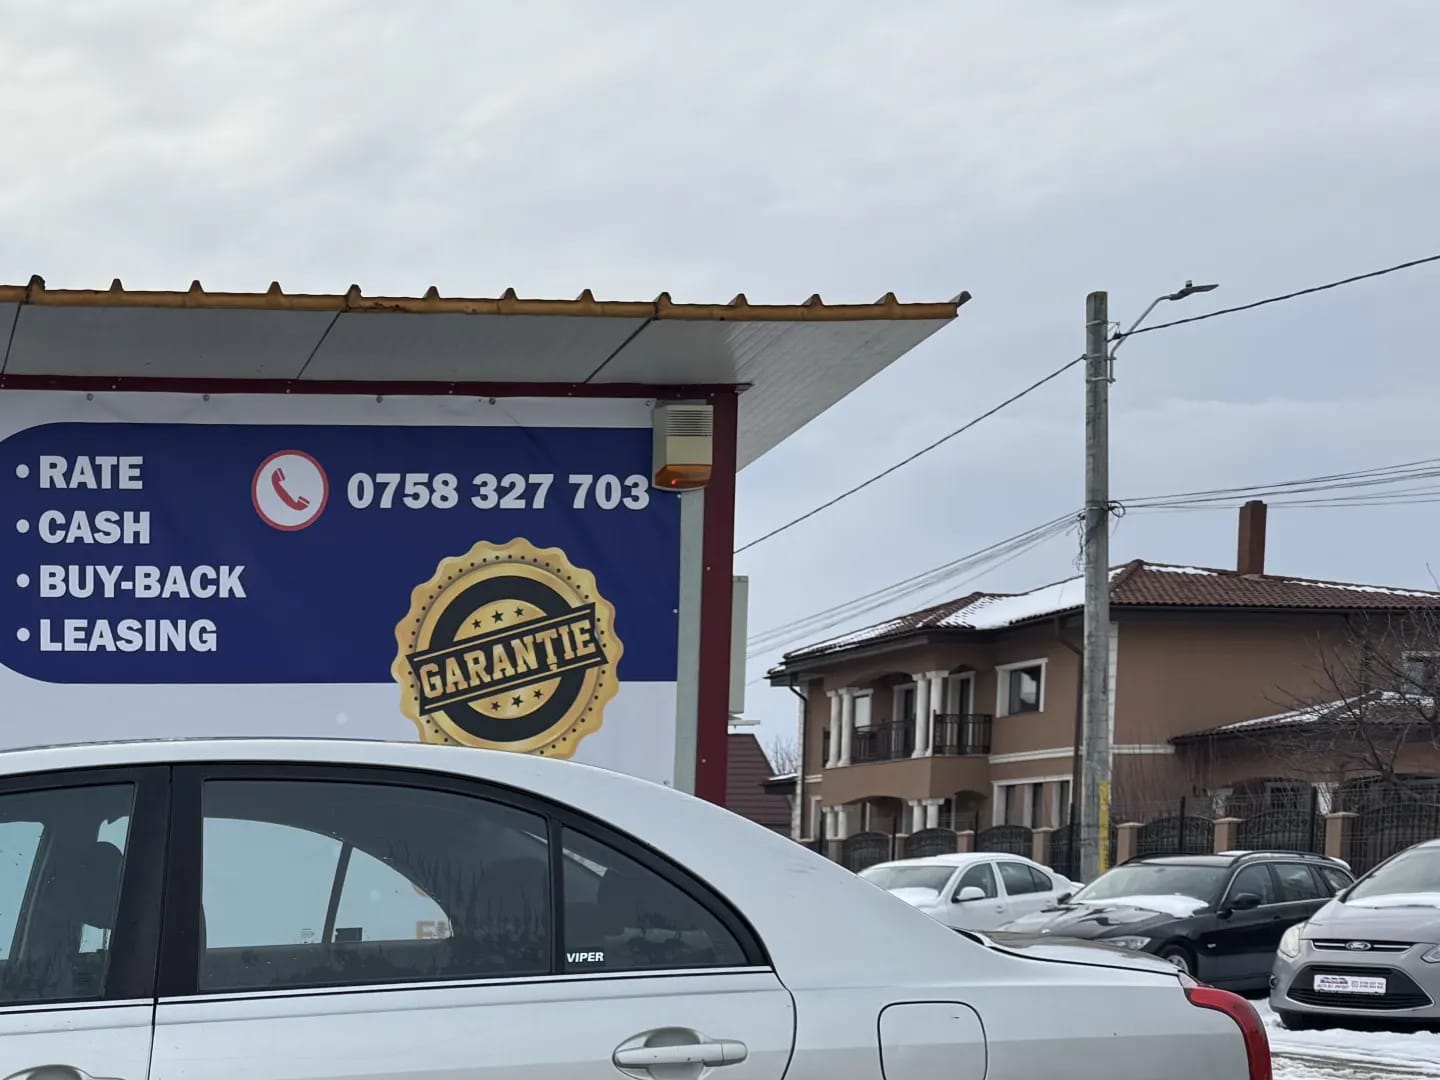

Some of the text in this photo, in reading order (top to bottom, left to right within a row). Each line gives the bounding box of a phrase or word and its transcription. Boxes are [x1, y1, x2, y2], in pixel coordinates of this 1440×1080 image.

[39, 455, 144, 490] RATE
[346, 472, 650, 511] 0758 327 703
[38, 509, 151, 545] CASH
[39, 564, 247, 599] BUY-BACK
[39, 618, 218, 653] LEASING
[566, 951, 604, 963] VIPER
